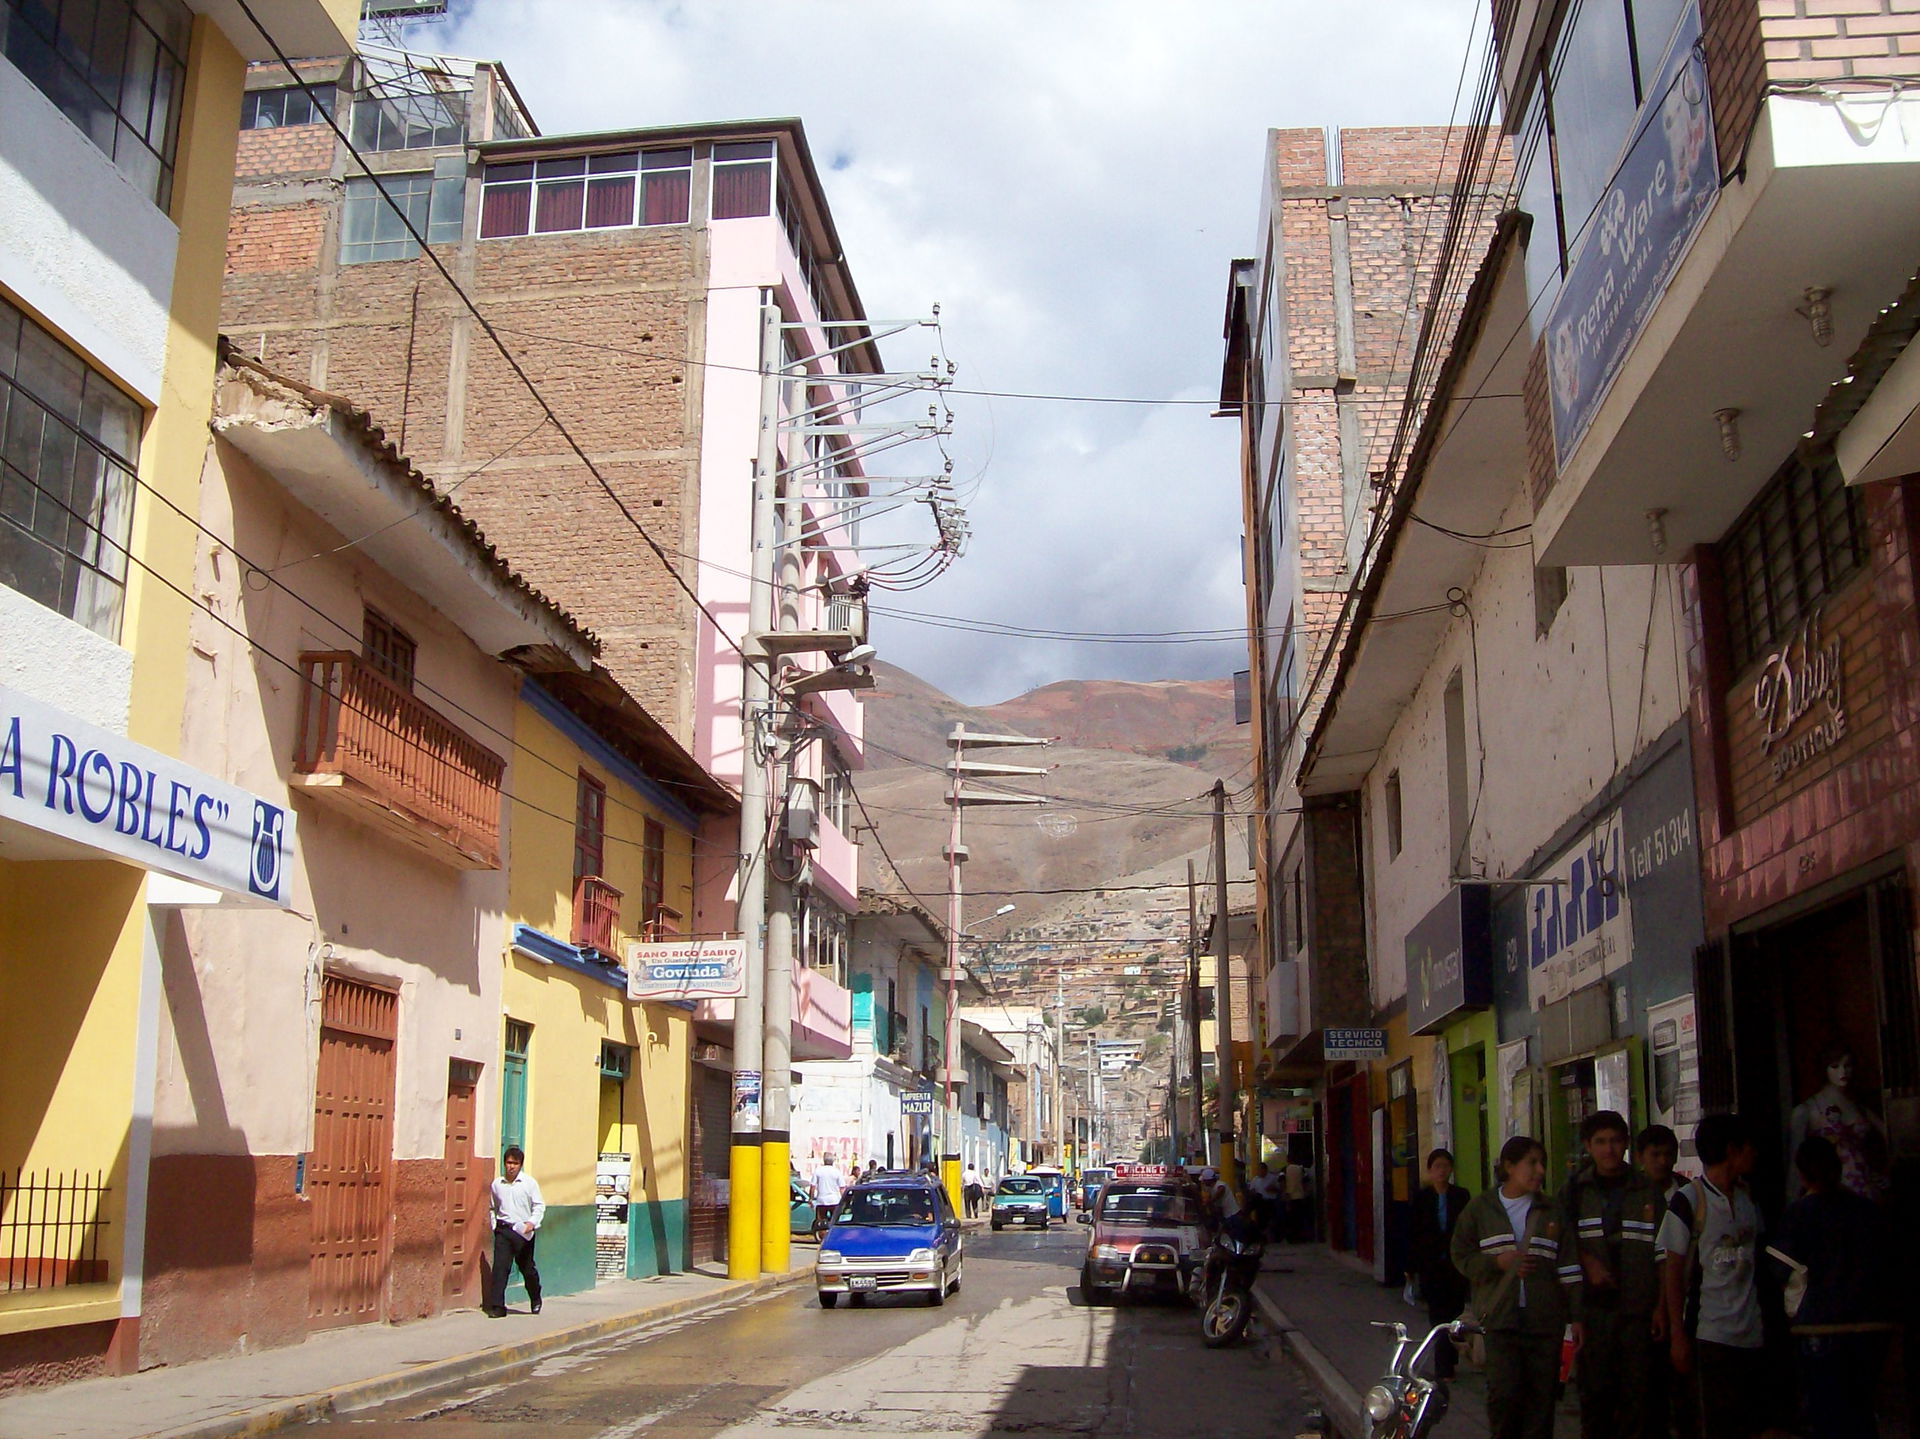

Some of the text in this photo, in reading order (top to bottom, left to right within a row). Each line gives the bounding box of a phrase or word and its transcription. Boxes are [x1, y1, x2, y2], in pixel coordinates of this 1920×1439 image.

[1577, 268, 1616, 355] Rena
[1619, 159, 1667, 266] Ware
[1593, 238, 1653, 359] INTERNATIONAL
[1772, 708, 1847, 783] BOUTIQUE
[636, 951, 668, 959] SANO
[703, 949, 737, 957] SABIO
[653, 966, 720, 978] Govinda
[1329, 1031, 1383, 1039] SERVICIO
[1329, 1039, 1383, 1047] TECNICO
[902, 1102, 932, 1113] MAZUR
[1124, 1165, 1157, 1174] RACING
